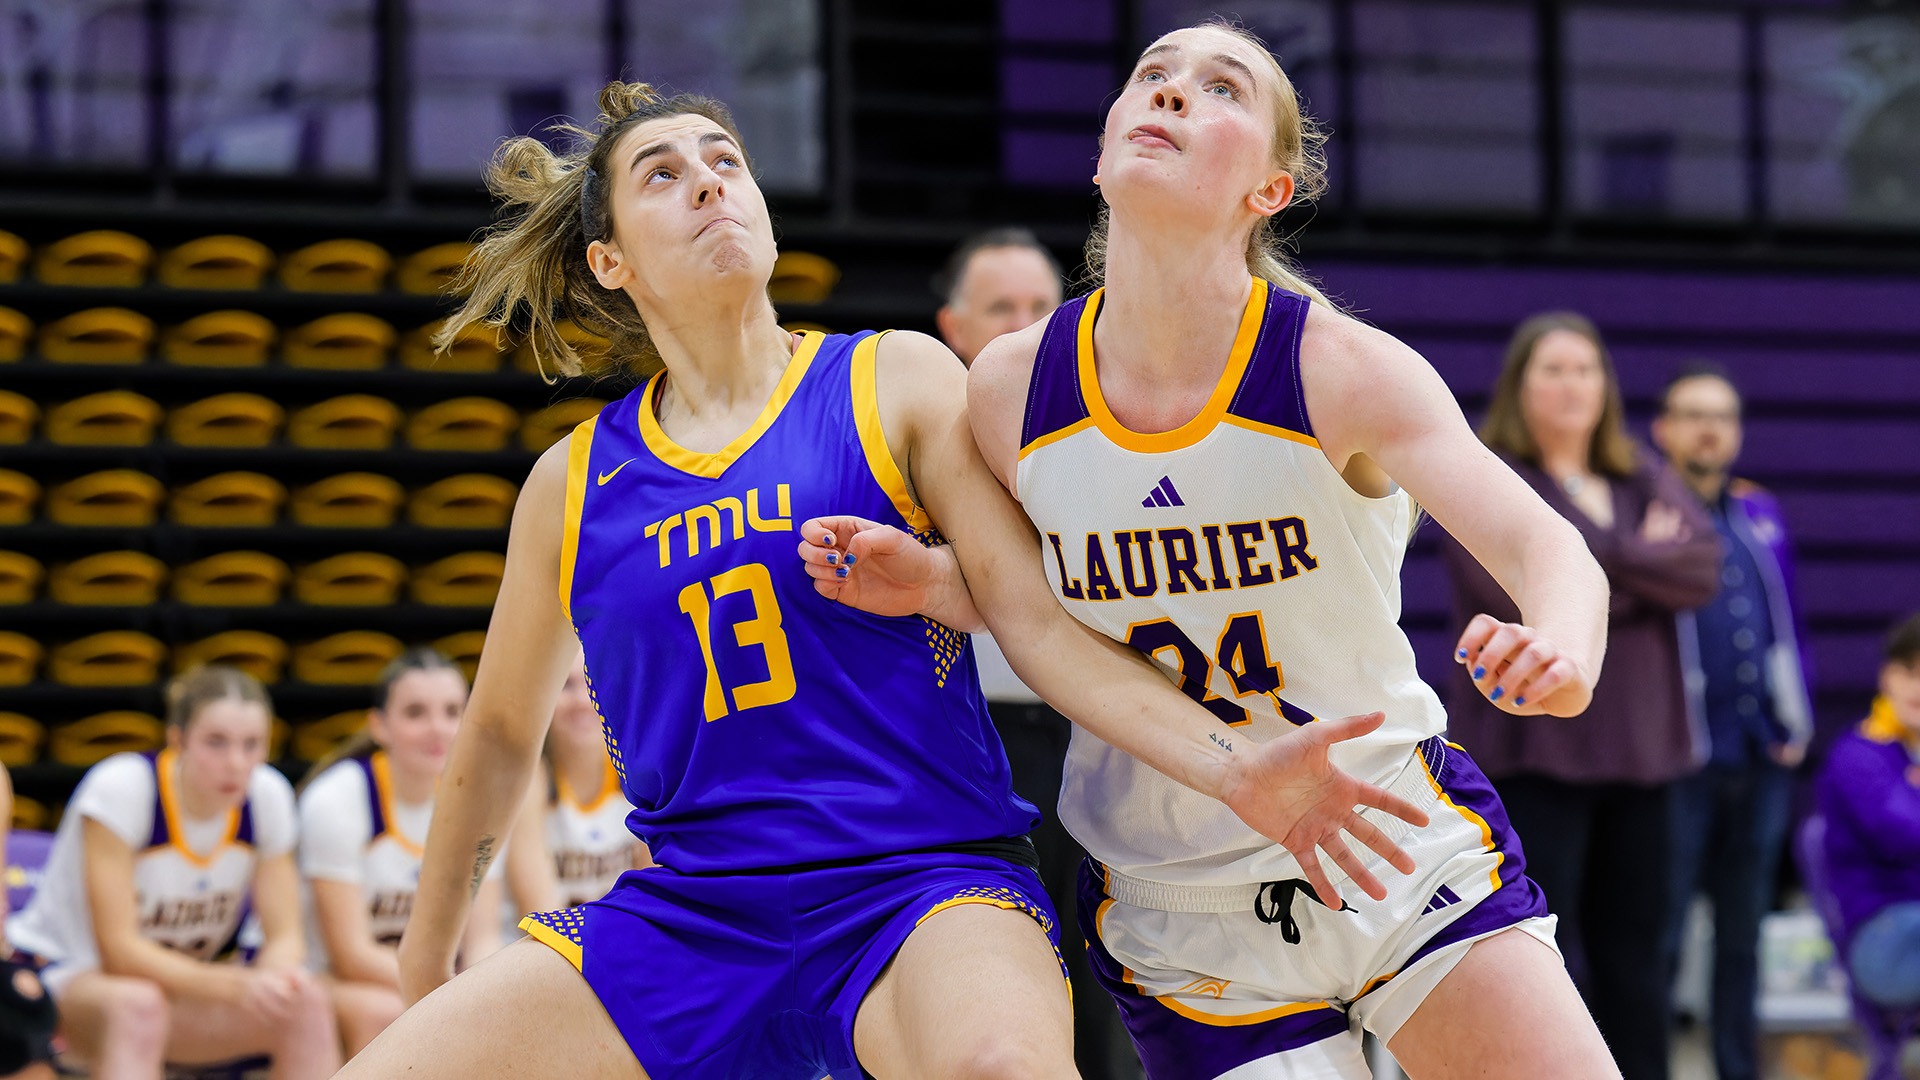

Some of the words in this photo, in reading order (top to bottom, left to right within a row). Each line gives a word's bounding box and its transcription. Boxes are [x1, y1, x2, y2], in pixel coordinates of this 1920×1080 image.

[644, 483, 793, 569] TMU
[1046, 515, 1320, 602] LAURIER
[678, 562, 797, 723] 13
[1124, 610, 1320, 728] 24
